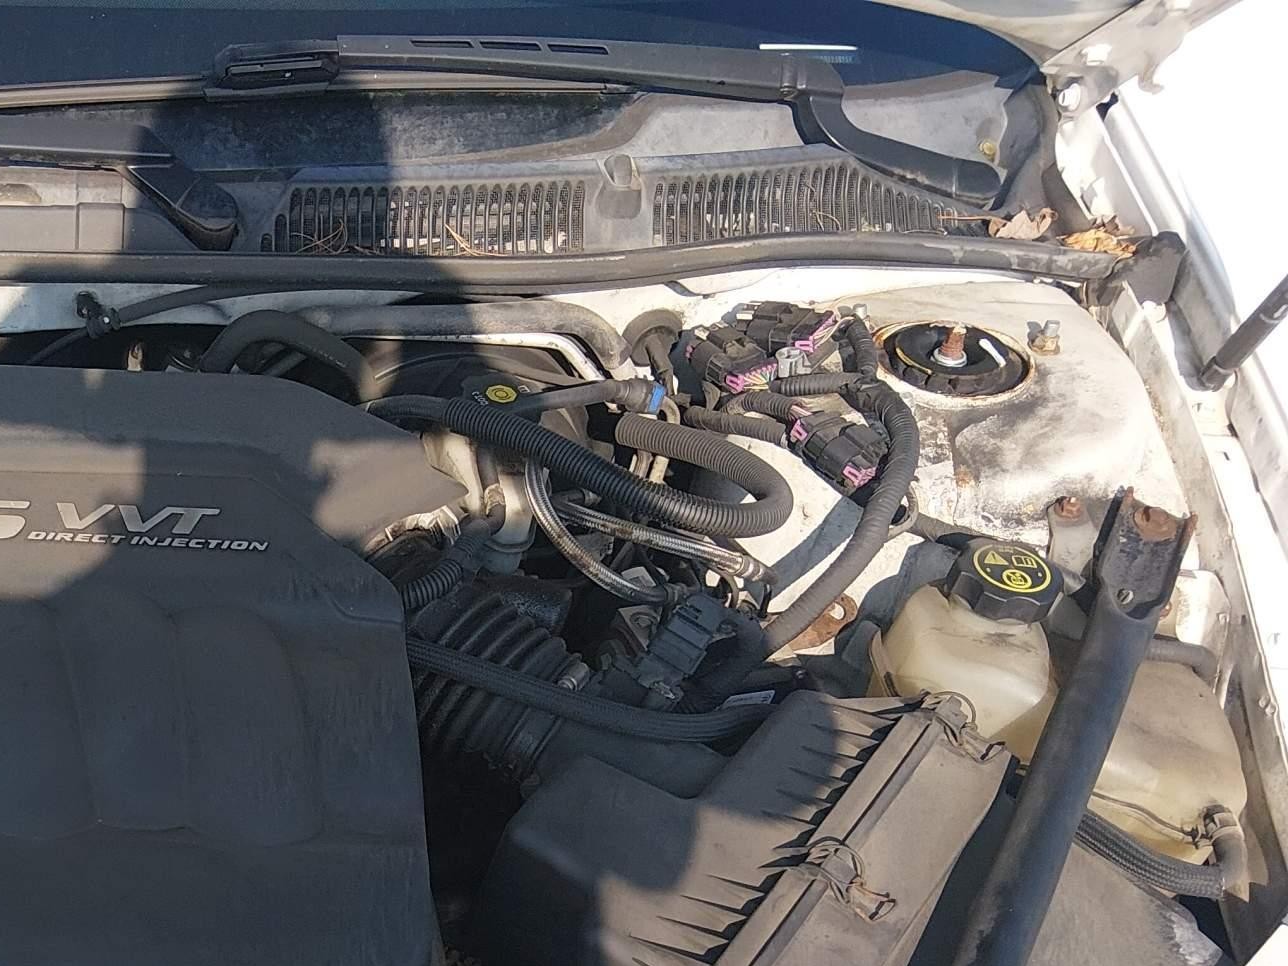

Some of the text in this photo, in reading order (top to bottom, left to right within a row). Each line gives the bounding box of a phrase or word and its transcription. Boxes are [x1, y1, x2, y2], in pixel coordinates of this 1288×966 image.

[56, 502, 221, 535] VVT
[27, 530, 269, 552] DIRECT INJECTION
